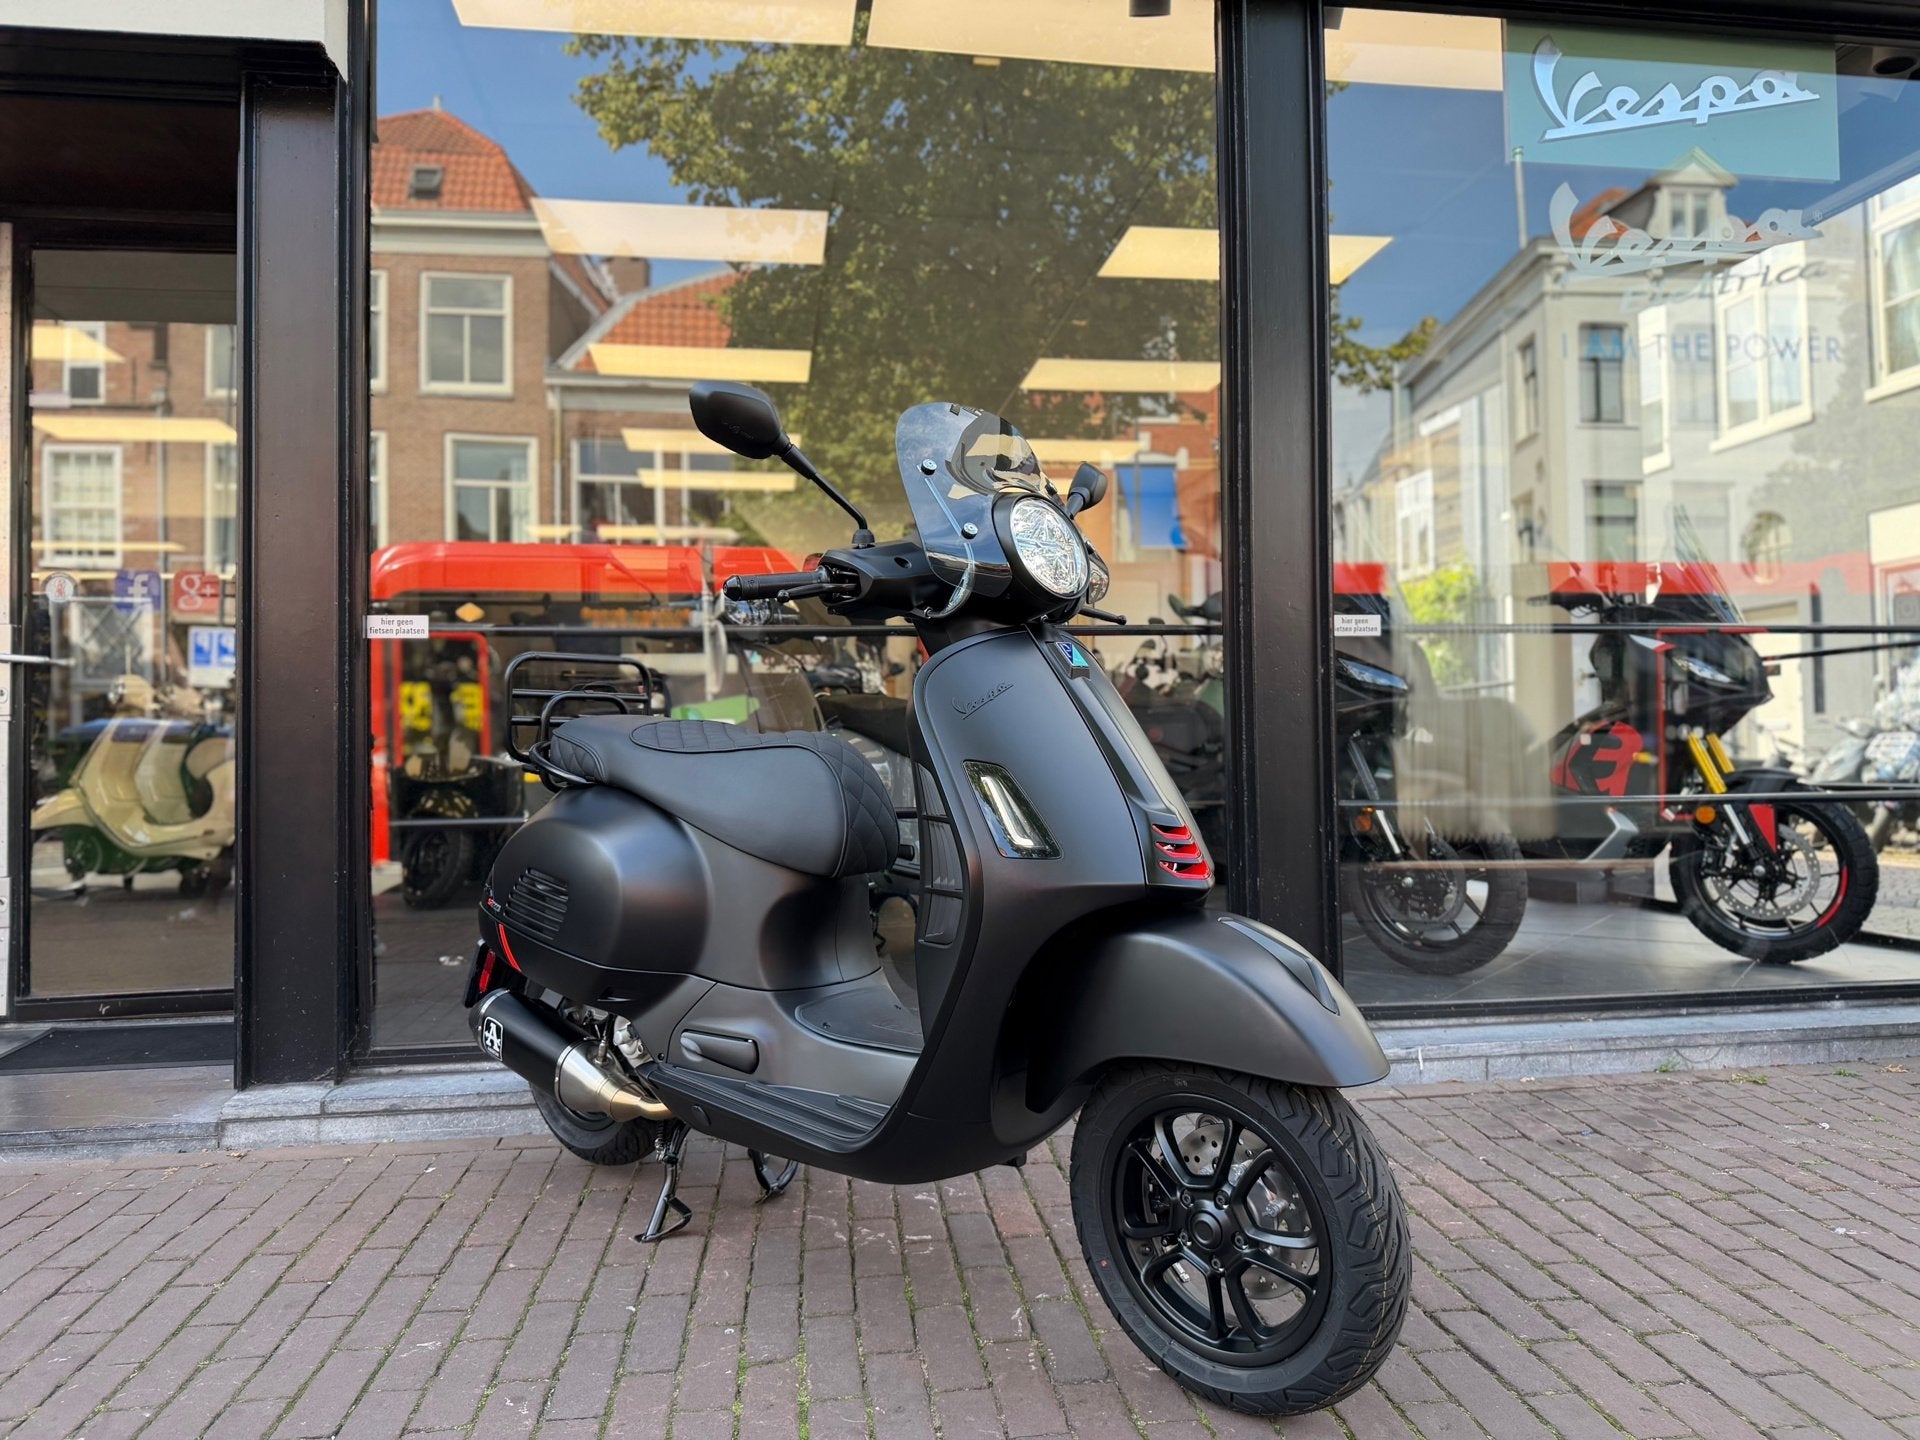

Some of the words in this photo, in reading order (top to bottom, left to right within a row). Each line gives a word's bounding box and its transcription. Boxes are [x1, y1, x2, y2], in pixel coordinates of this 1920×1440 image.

[1531, 34, 1820, 142] Vespa
[1586, 332, 1638, 359] AM
[1653, 333, 1713, 361] THE
[1726, 333, 1842, 363] POWER
[380, 618, 395, 626] hier
[396, 619, 414, 627] geen
[1341, 616, 1353, 624] hier
[1354, 618, 1369, 626] geen
[369, 626, 394, 634] fietsen
[395, 627, 425, 636] plaatsen
[1353, 626, 1378, 634] plaatsen
